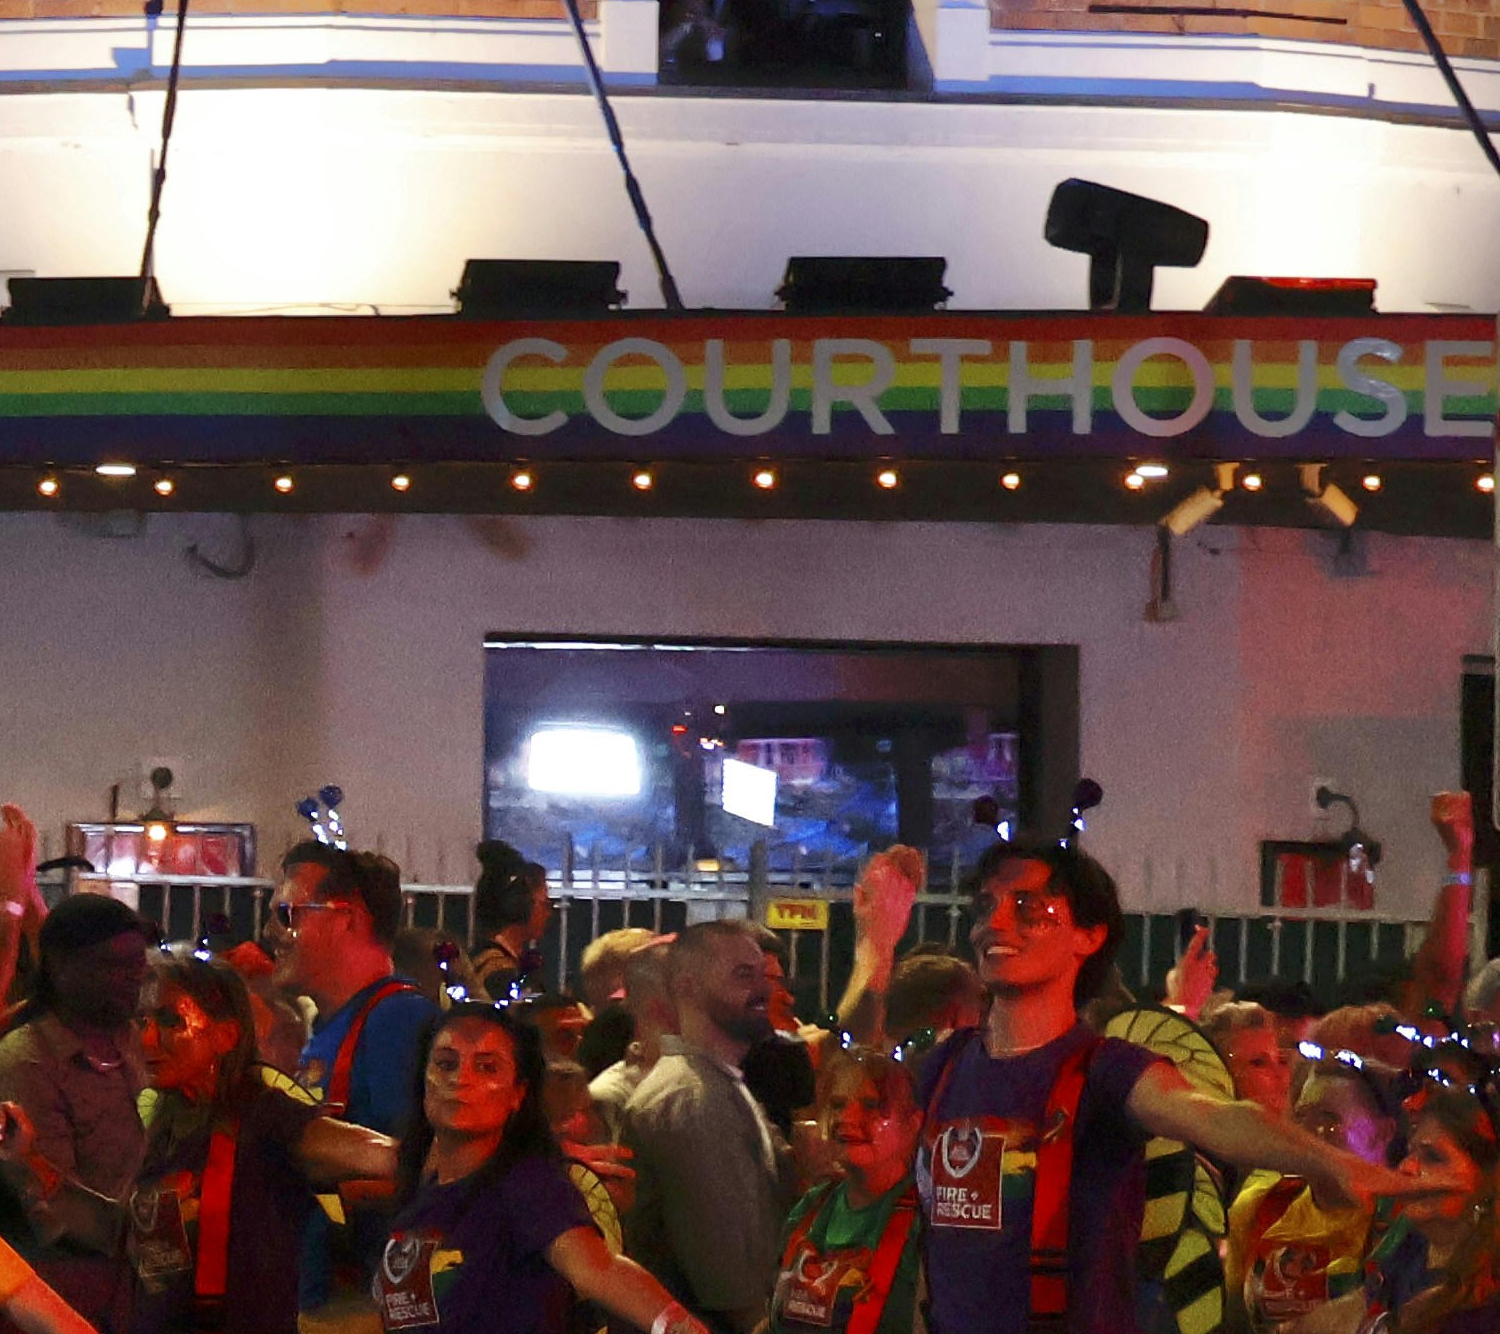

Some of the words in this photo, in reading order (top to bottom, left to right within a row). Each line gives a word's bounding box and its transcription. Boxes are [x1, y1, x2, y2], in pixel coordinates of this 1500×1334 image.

[481, 336, 1495, 439] COURTHOUSE
[936, 1186, 968, 1201] FIRE
[936, 1202, 992, 1220] RESCUE
